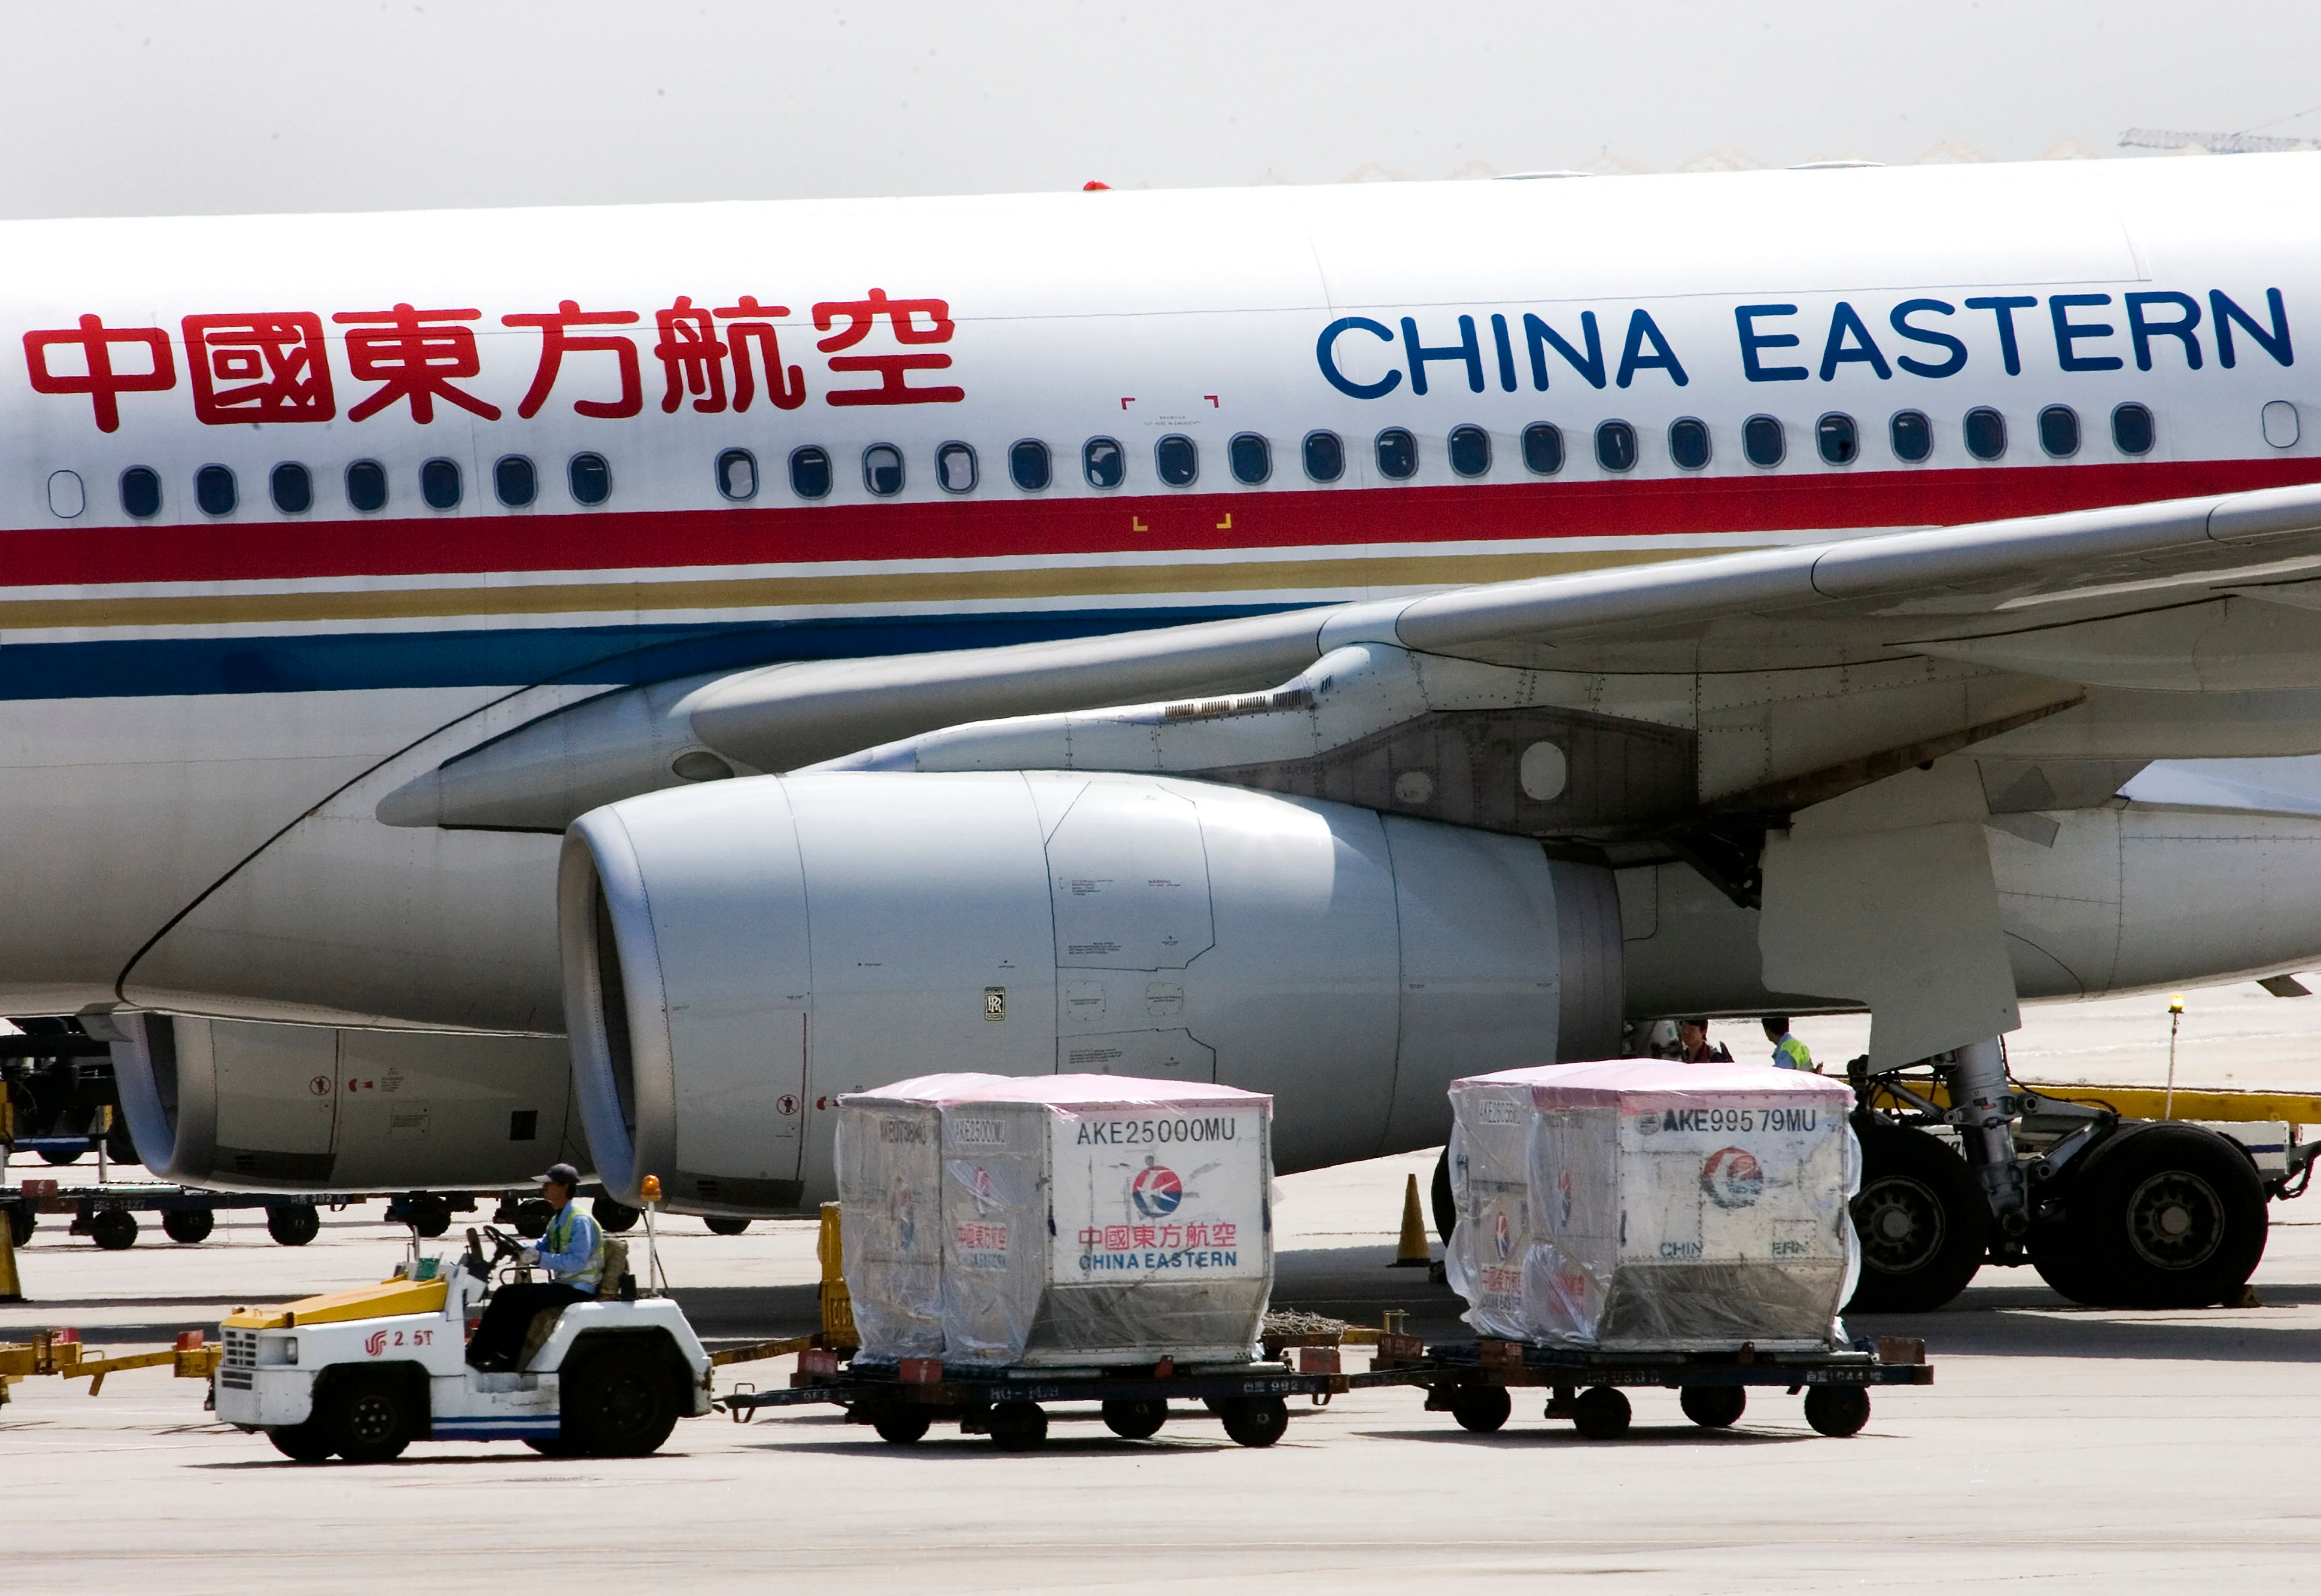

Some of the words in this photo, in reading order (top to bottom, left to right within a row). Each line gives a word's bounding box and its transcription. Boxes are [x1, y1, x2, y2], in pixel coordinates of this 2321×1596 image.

[1316, 309, 1689, 400] CHINA
[1734, 287, 2293, 383] EASTERN
[23, 288, 964, 432] 中國東方航空
[1077, 1117, 1235, 1145] AKE25000MU
[1079, 1223, 1236, 1251] 中國東方航空
[1079, 1253, 1139, 1270] CHINA
[1144, 1251, 1237, 1269] EASTERN
